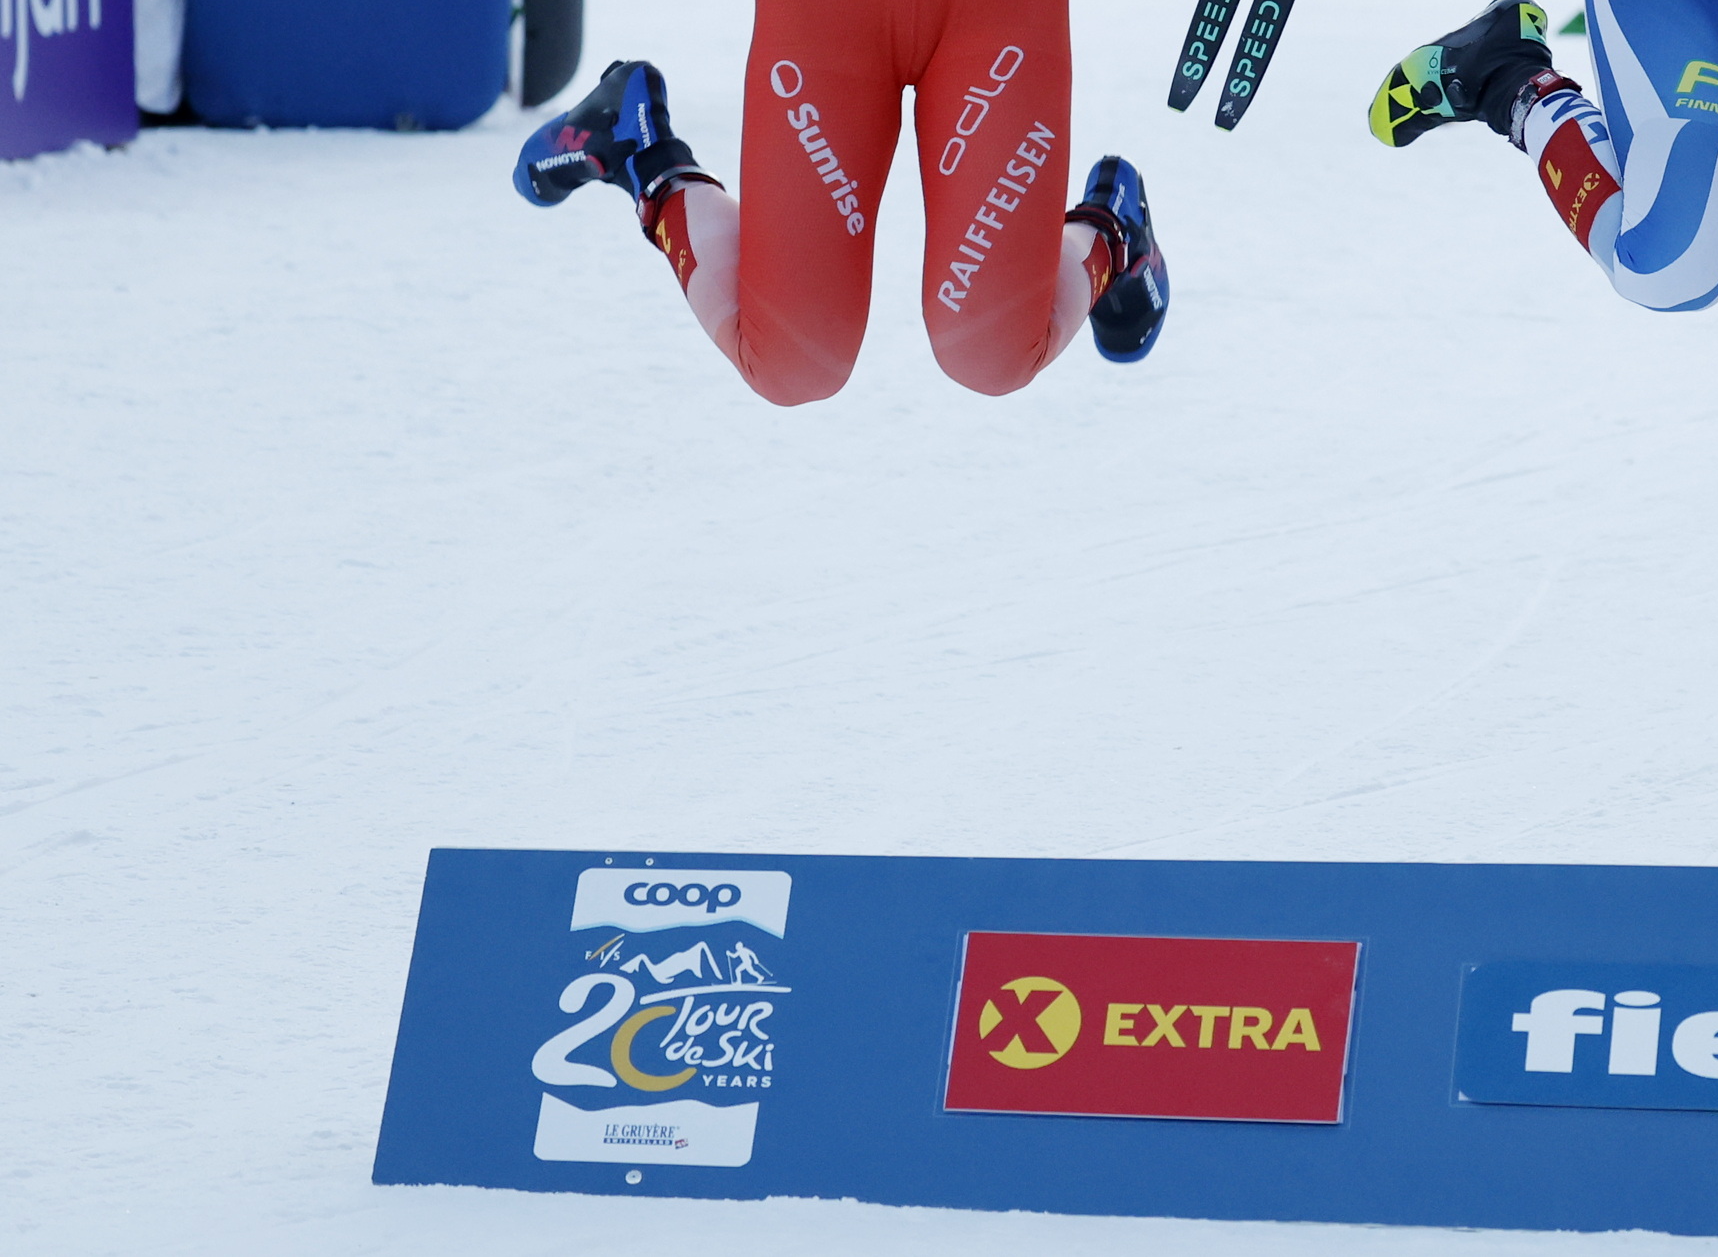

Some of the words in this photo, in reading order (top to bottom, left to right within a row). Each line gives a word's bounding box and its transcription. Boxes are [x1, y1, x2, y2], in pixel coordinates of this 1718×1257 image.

[1229, 0, 1280, 98] SPEED
[1545, 159, 1563, 190] 1
[936, 121, 1057, 313] RAIFFEISEN
[624, 882, 742, 913] coop
[1103, 1003, 1321, 1052] EXTRA
[665, 1036, 704, 1065] de
[702, 1075, 772, 1088] YEARS
[604, 1124, 620, 1137] LE
[621, 1122, 676, 1139] GRUYÈRE
